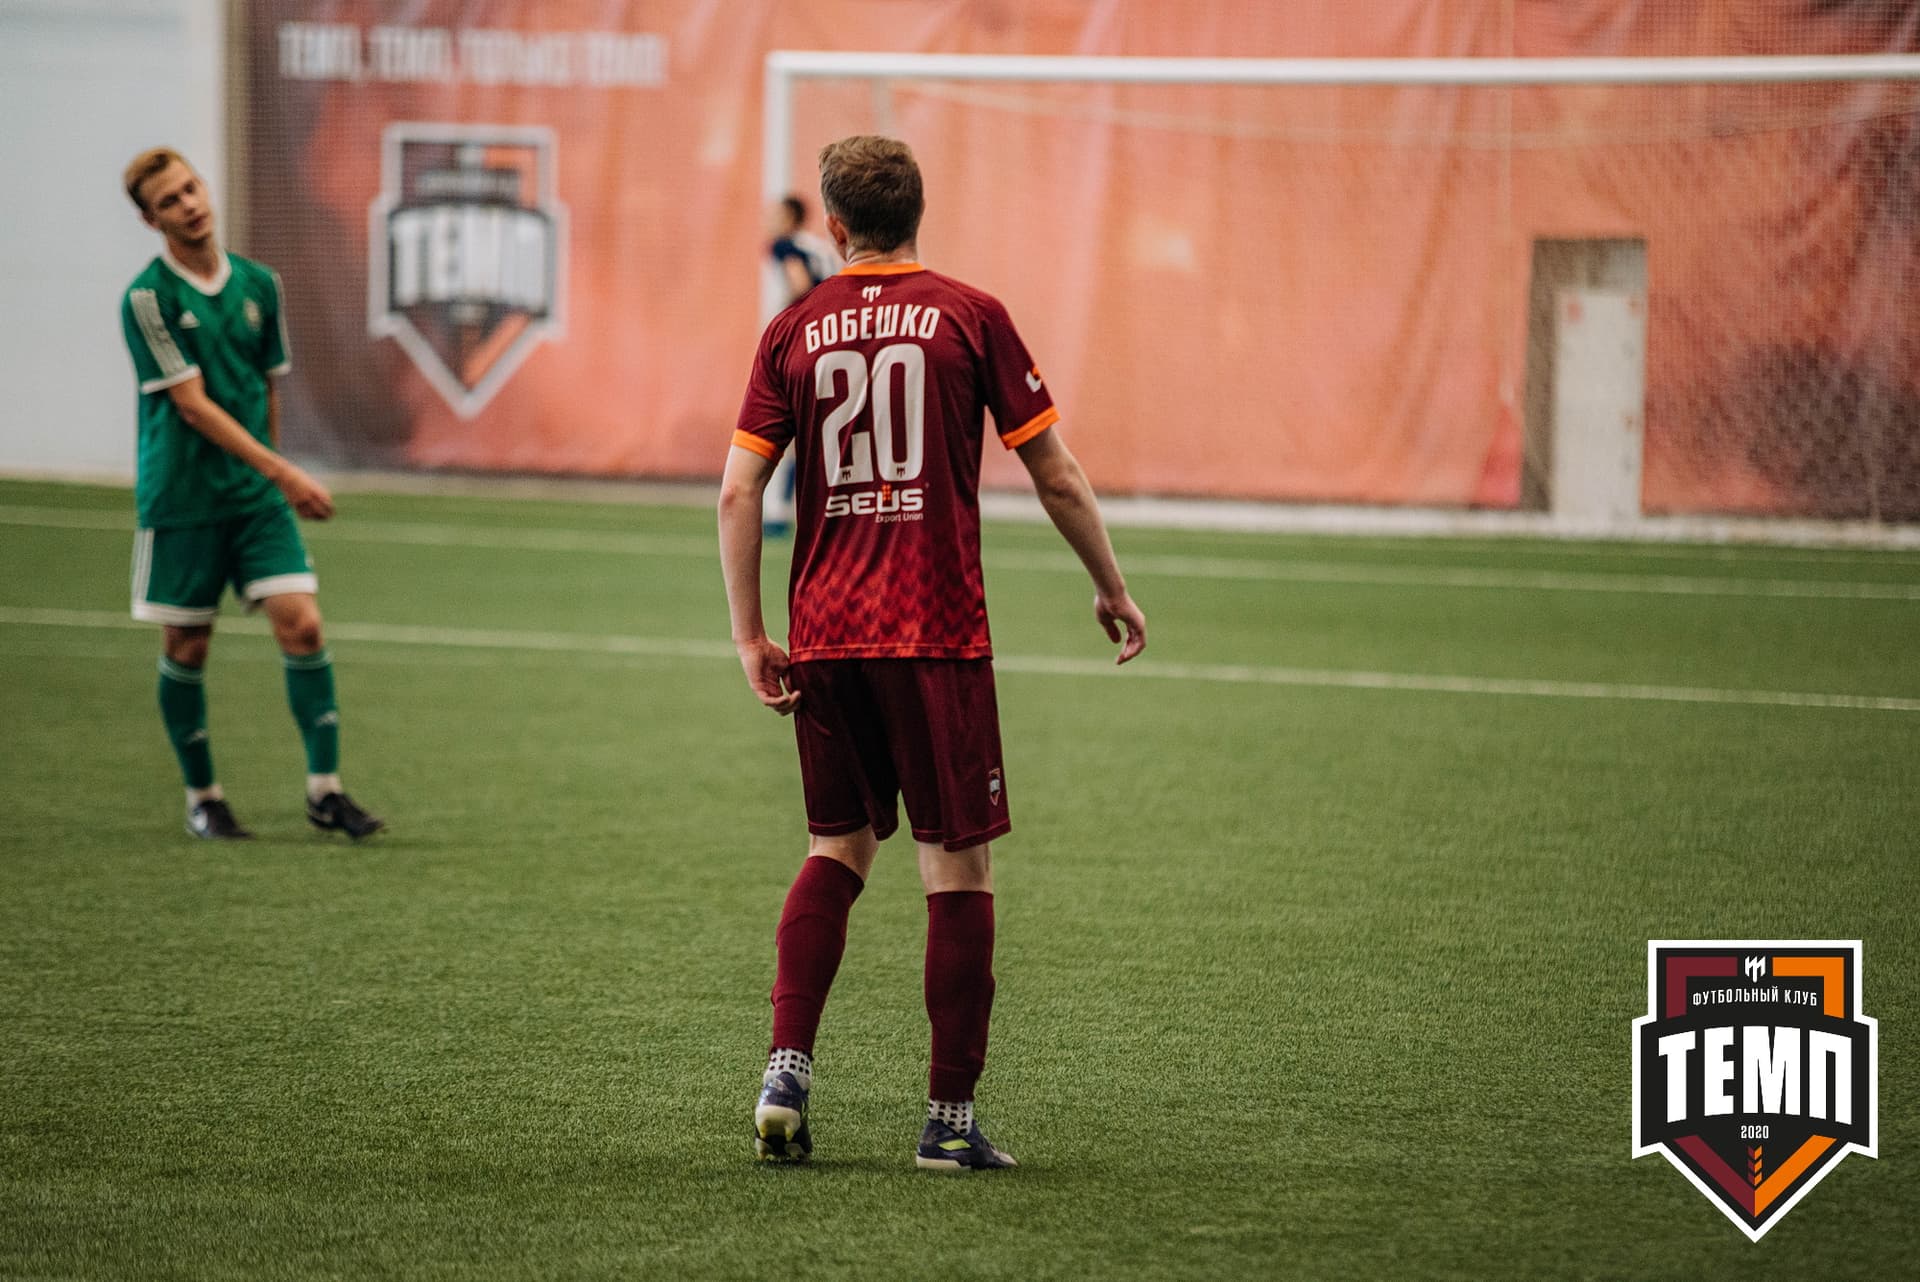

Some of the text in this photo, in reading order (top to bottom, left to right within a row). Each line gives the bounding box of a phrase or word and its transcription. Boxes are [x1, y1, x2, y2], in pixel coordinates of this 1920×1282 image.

[805, 304, 940, 353] БОБЕШКО
[815, 343, 925, 487] 20
[875, 512, 924, 523] Export Union
